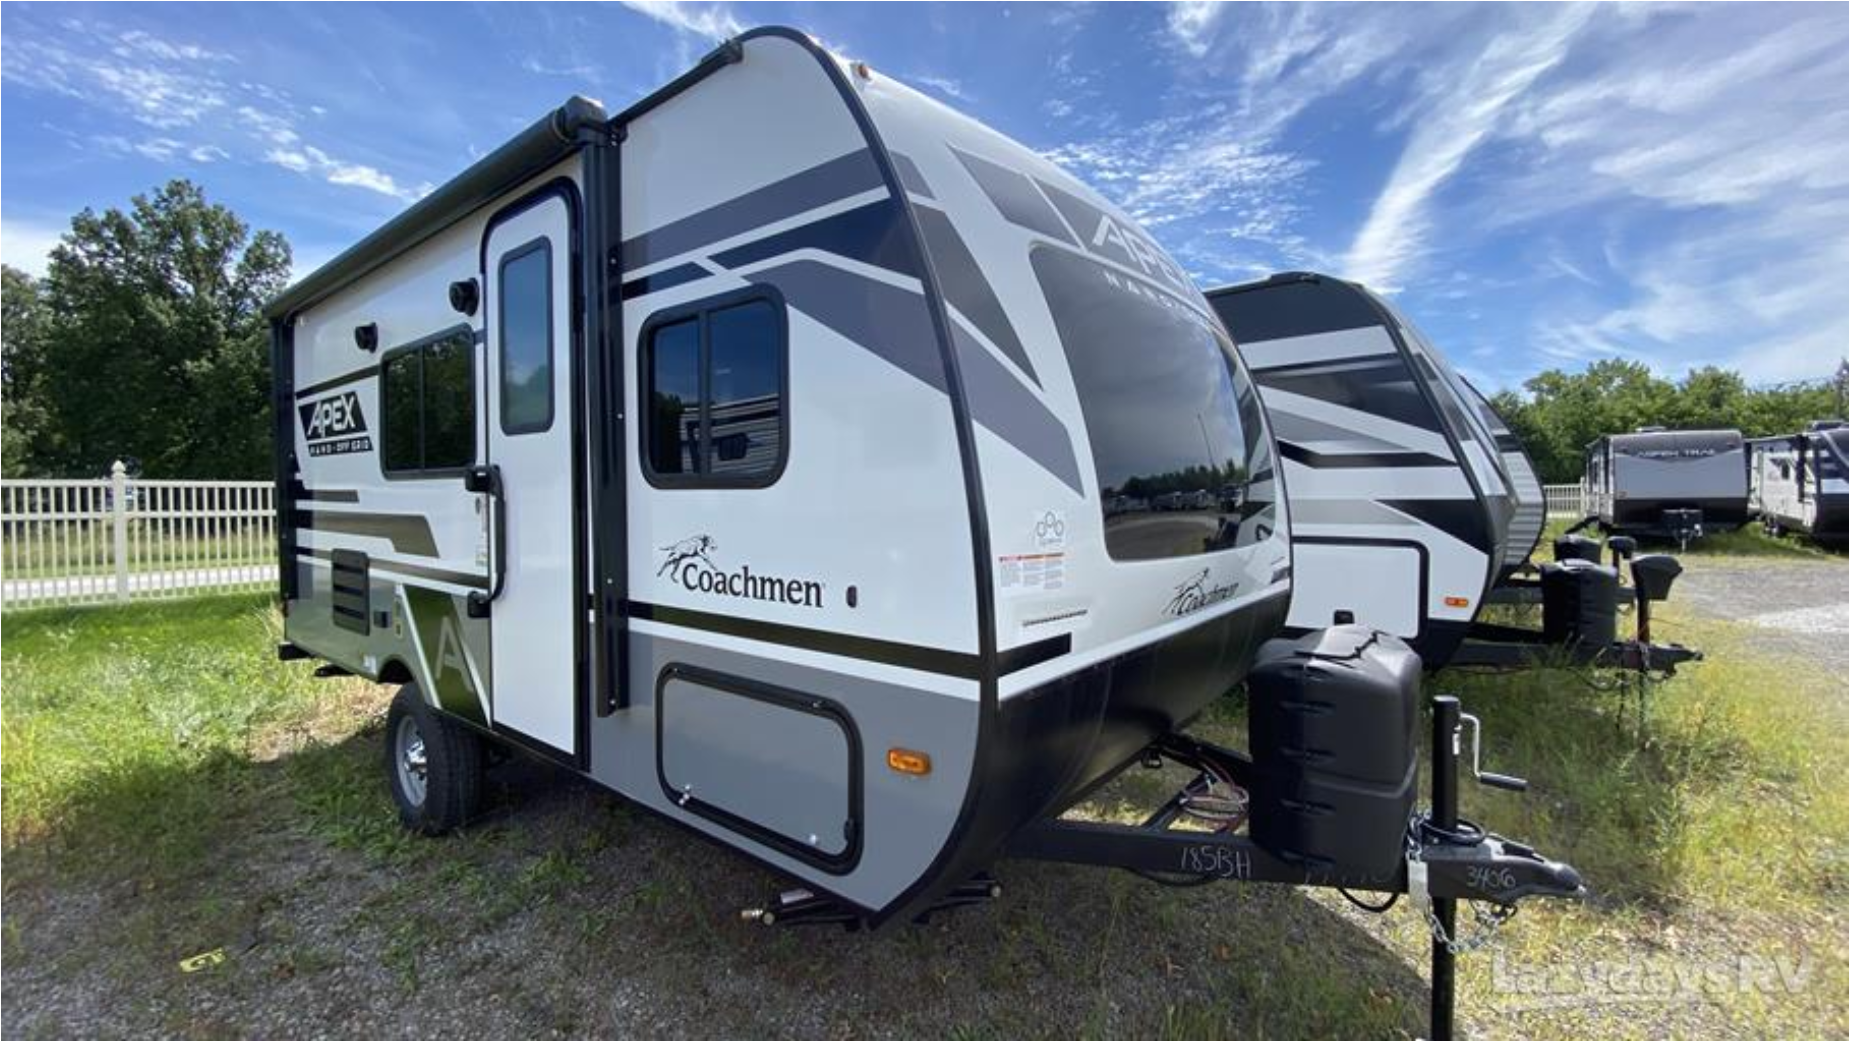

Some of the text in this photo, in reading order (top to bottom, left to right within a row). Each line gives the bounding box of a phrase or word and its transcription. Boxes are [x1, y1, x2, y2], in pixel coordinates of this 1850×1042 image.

[308, 394, 356, 438] APEX
[682, 563, 824, 608] Coachmen
[1180, 844, 1252, 879] 185BH
